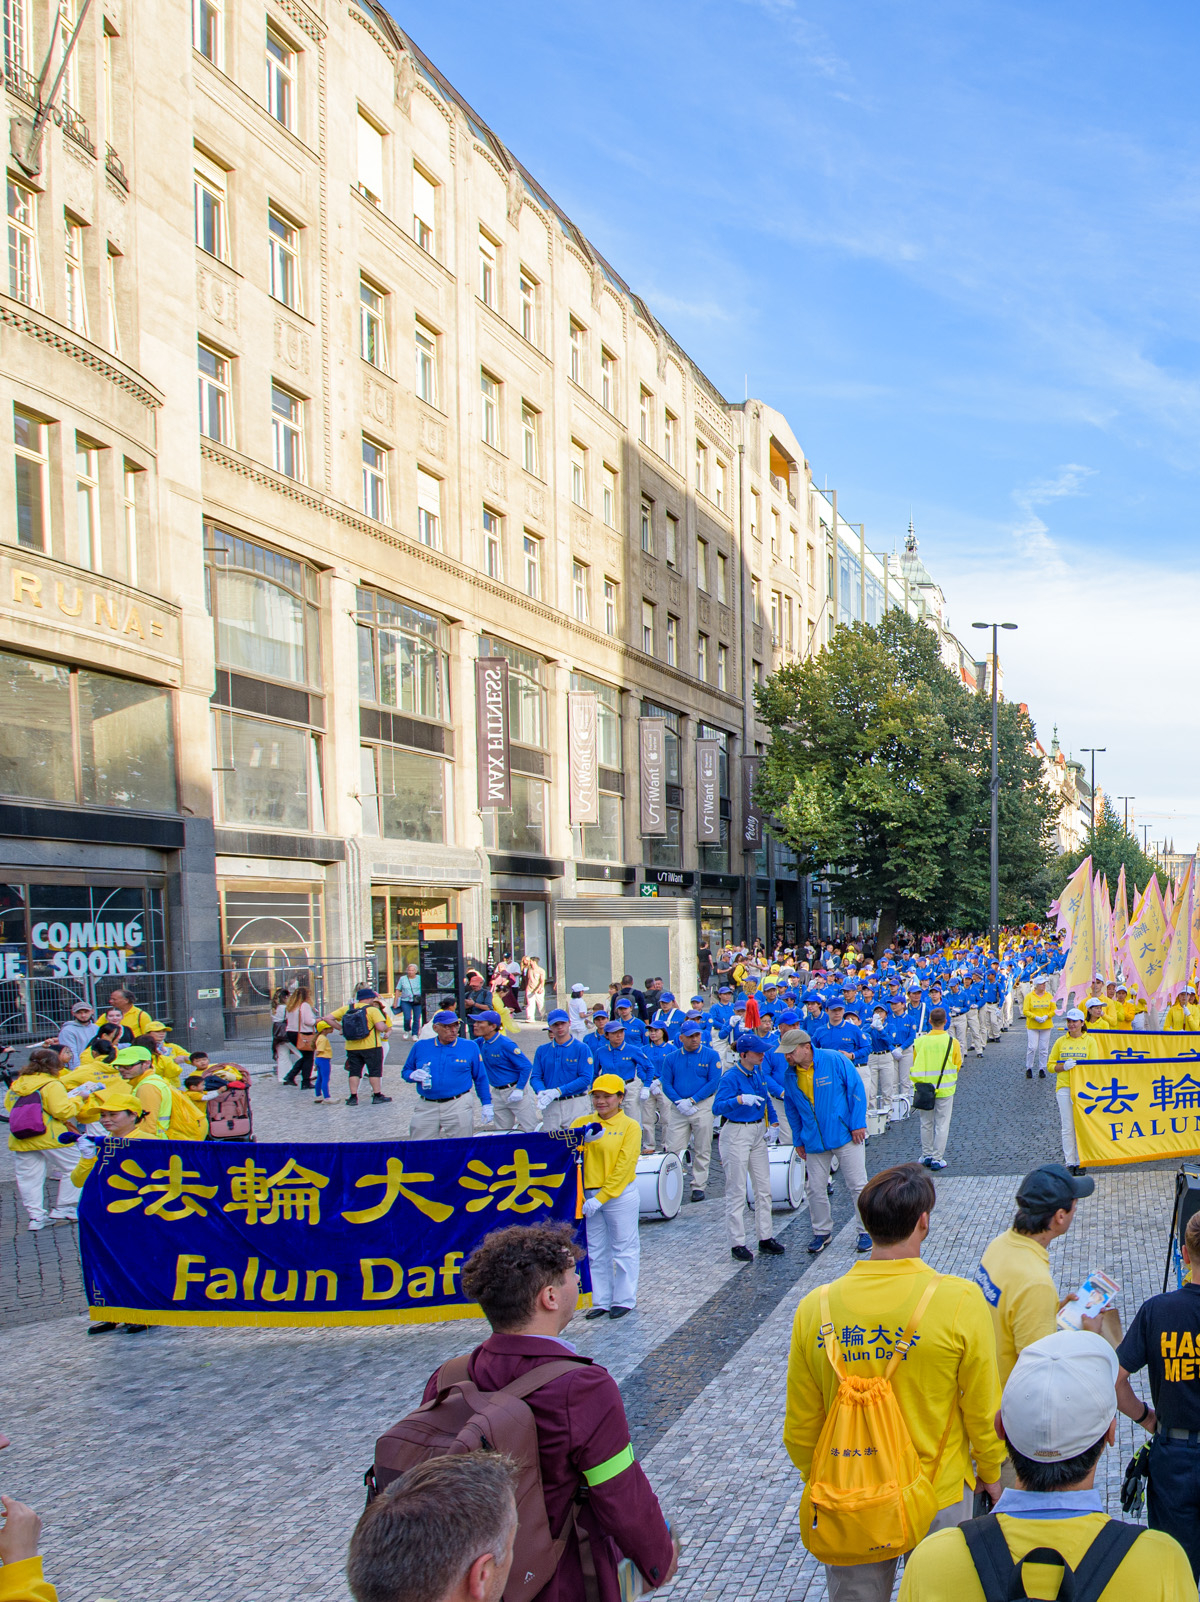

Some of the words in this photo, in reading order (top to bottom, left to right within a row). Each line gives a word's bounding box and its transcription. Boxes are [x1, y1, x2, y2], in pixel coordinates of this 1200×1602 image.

[578, 749, 591, 787] iWant
[648, 768, 660, 801] iWant
[704, 783, 714, 814] iWant
[667, 872, 684, 883] iWant
[32, 922, 143, 949] COMING
[53, 950, 127, 977] SOON
[106, 1149, 566, 1226] 法輪大法
[172, 1254, 338, 1302] Falun
[360, 1251, 463, 1299] Daf
[842, 1350, 870, 1362] alun
[875, 1347, 907, 1360] Daa
